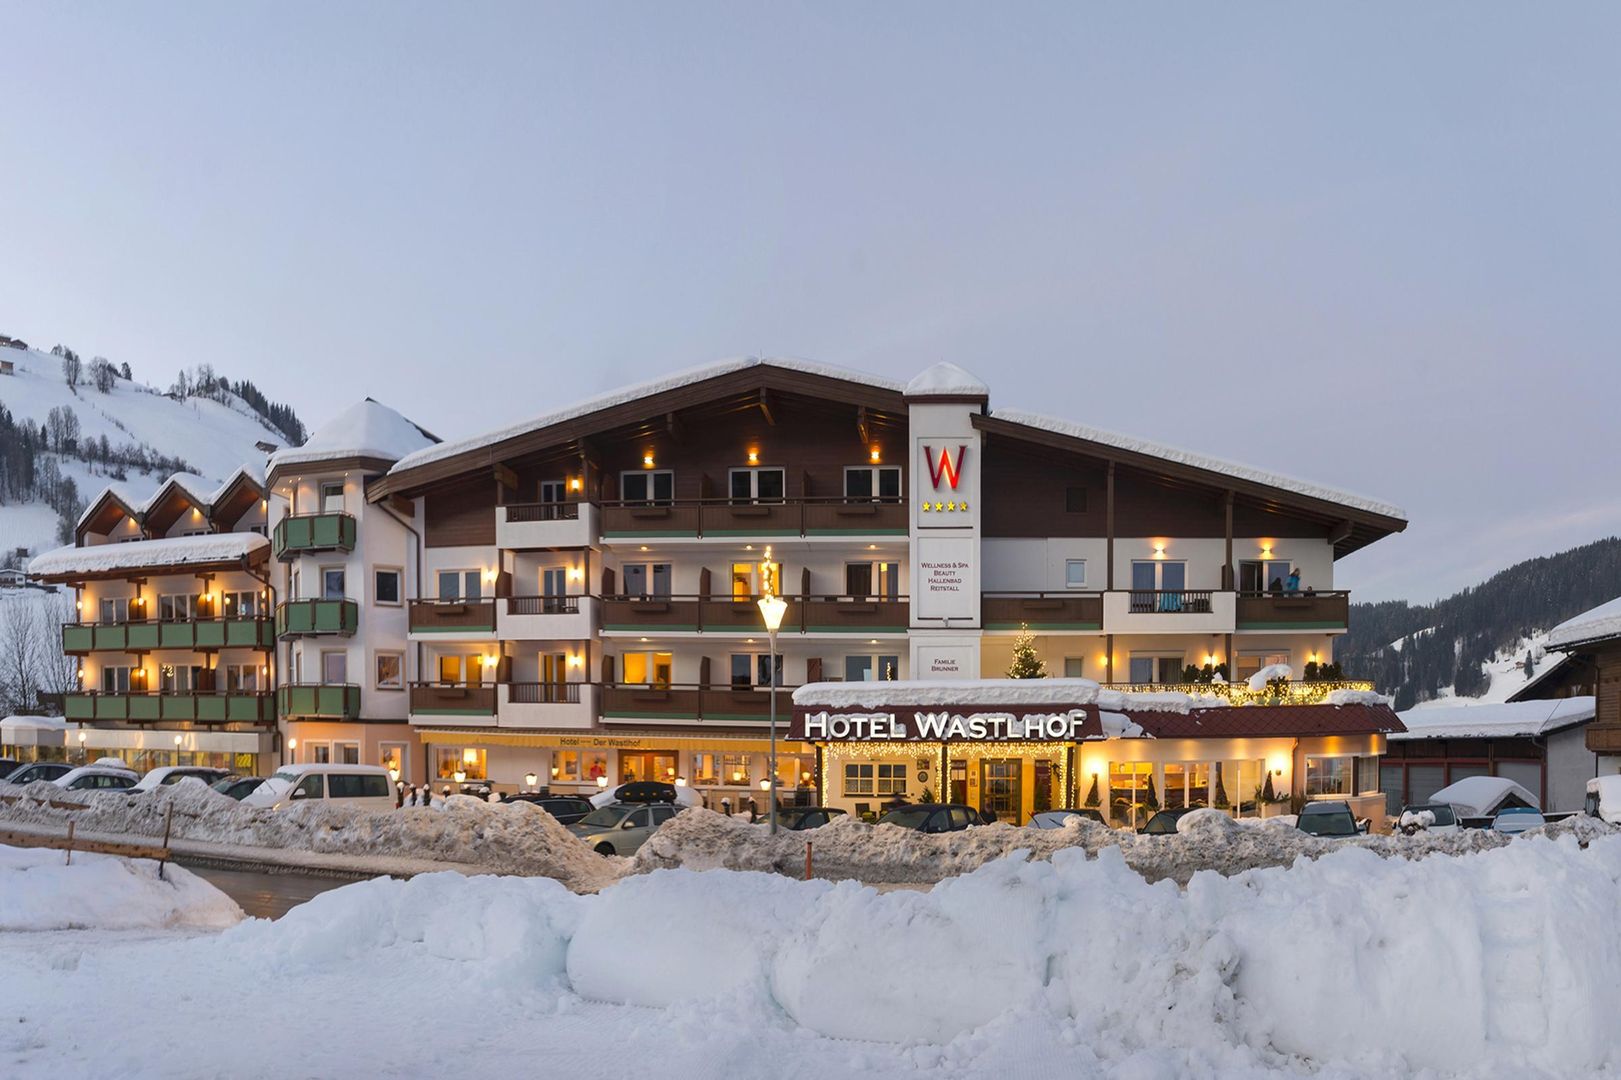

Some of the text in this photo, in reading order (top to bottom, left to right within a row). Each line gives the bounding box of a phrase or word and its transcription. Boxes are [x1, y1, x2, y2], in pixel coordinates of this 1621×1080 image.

[923, 446, 967, 490] W
[804, 712, 1085, 738] HOTEL WASTLHOF
[560, 737, 580, 746] Hotel
[593, 738, 607, 746] Der
[608, 739, 641, 747] Wastlhof
